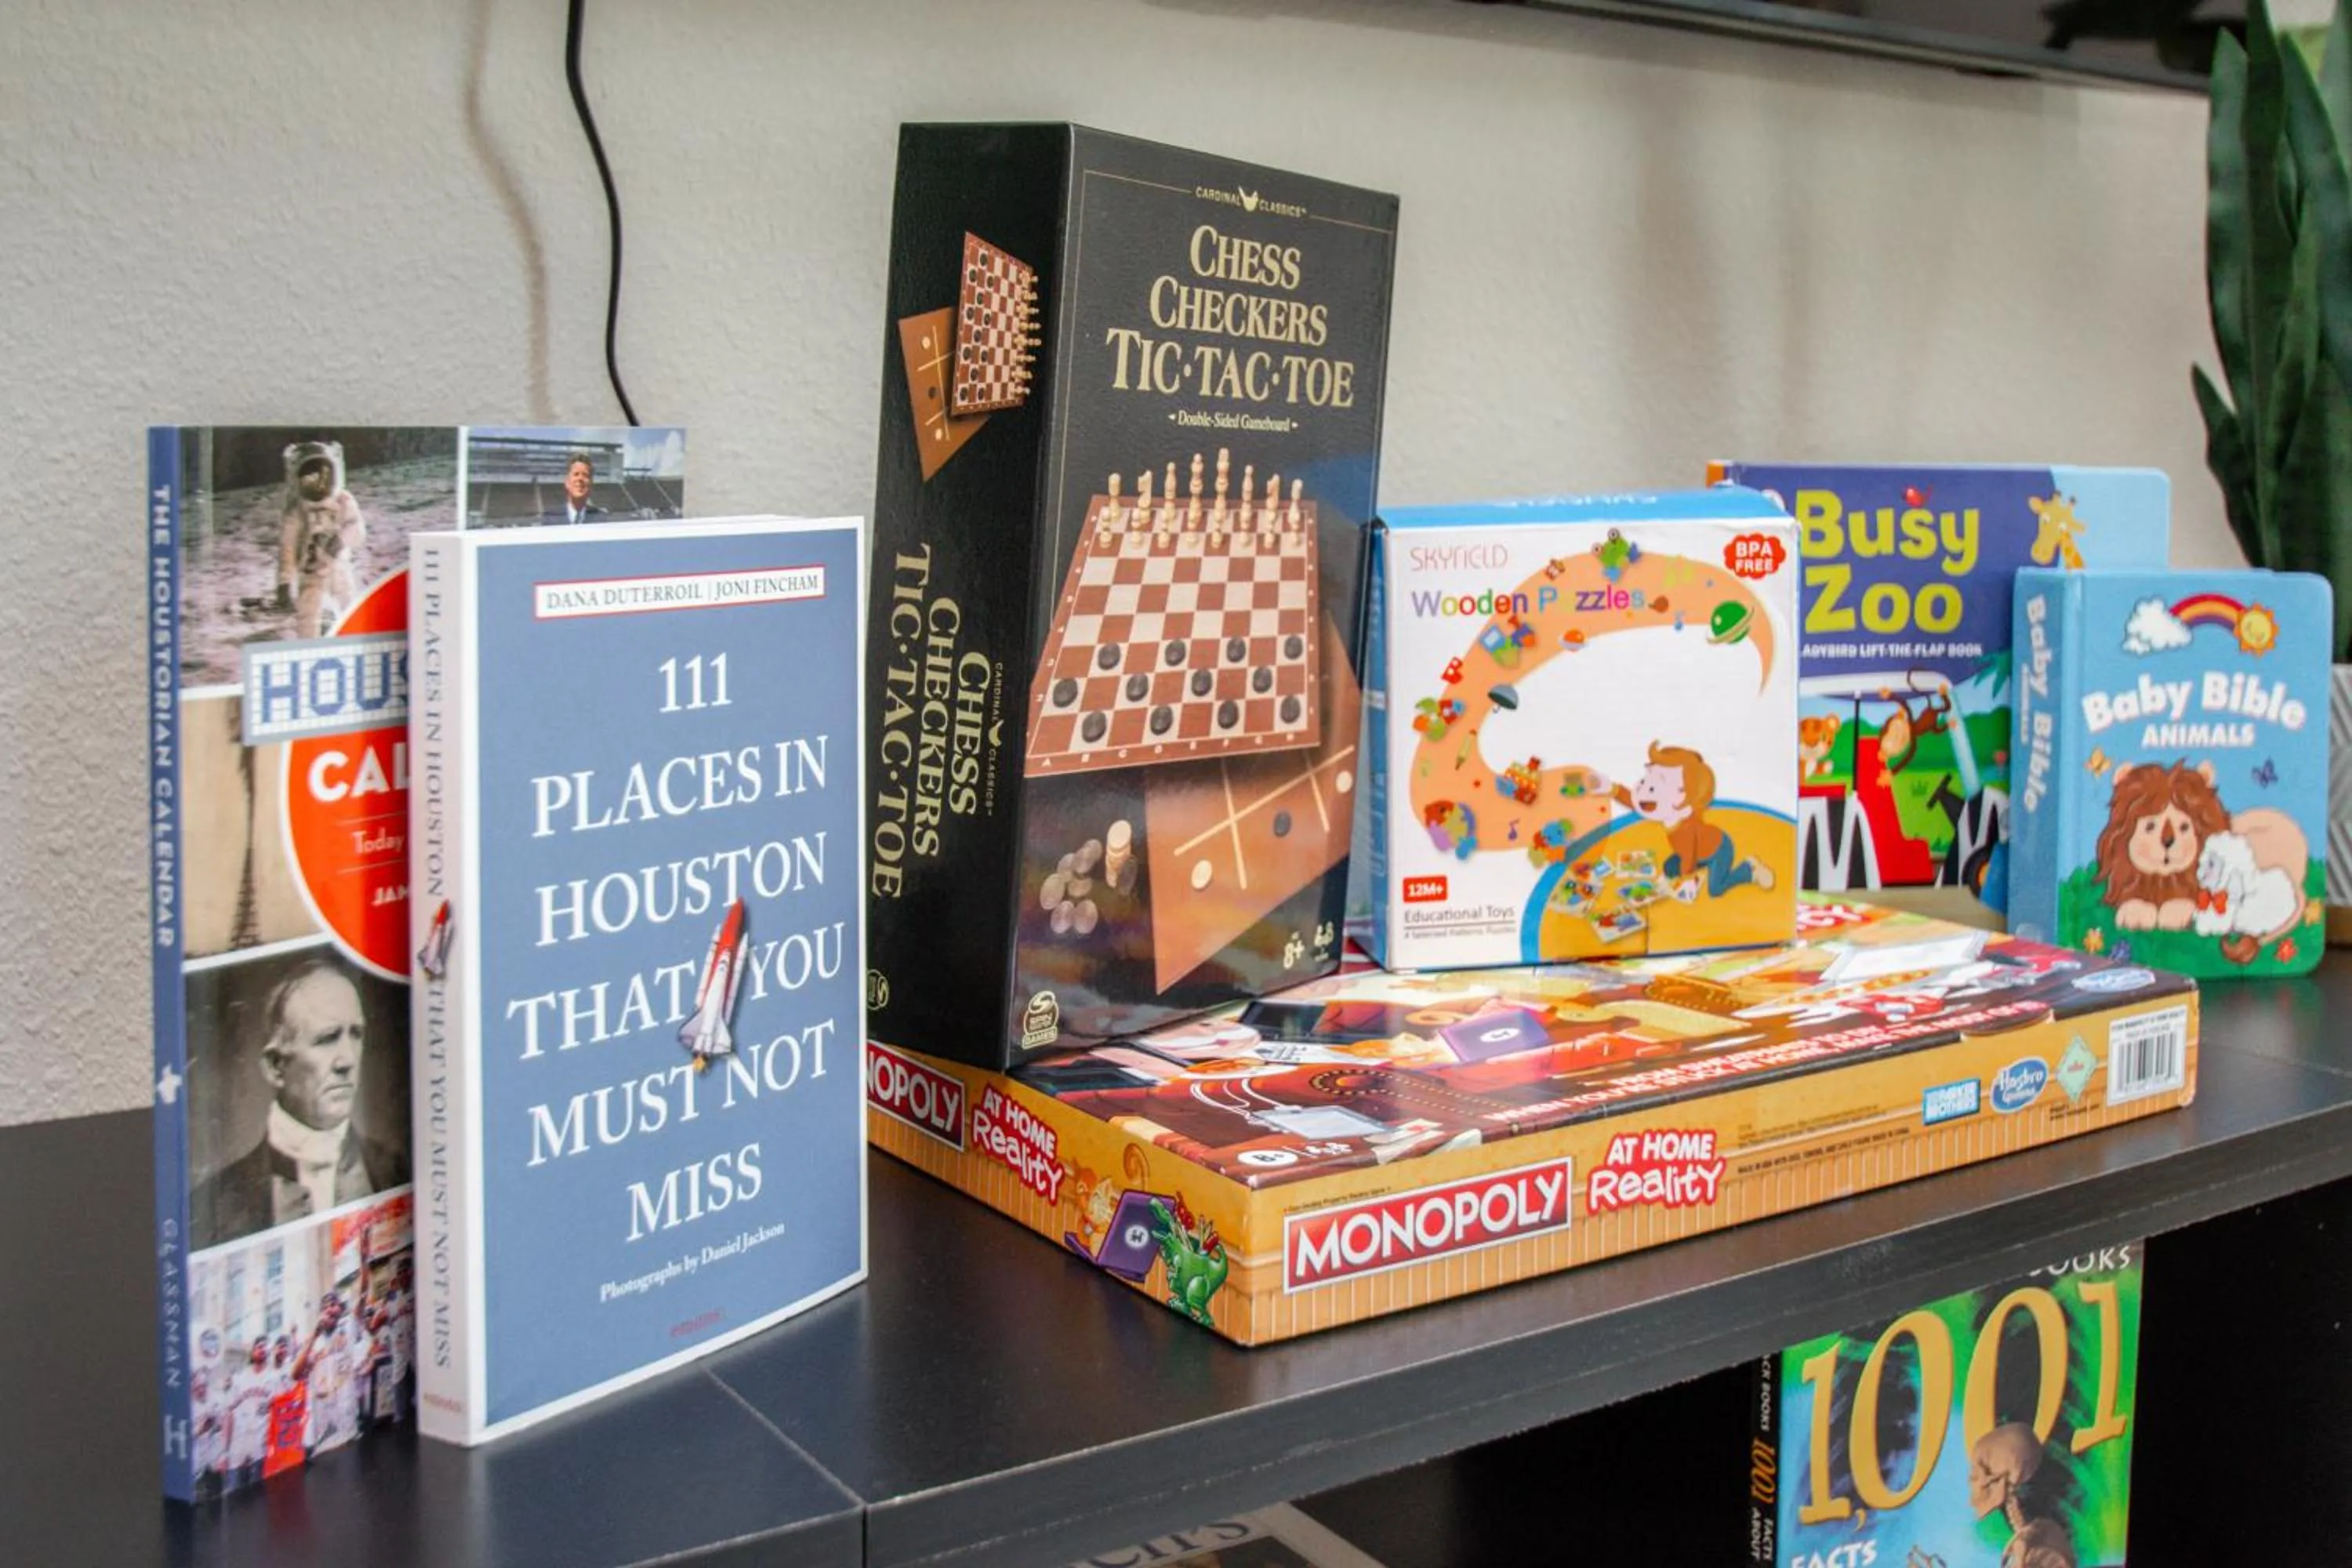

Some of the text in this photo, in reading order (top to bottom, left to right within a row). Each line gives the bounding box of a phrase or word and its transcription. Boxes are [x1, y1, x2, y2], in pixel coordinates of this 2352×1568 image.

[1195, 186, 1242, 209] CARDINAL
[1189, 225, 1302, 289] CHESS
[1149, 275, 1328, 347] CHECKERS
[1735, 540, 1773, 559] BPA
[1736, 558, 1773, 574] FREE
[1795, 488, 1980, 576] Busy
[547, 588, 600, 611] DANA
[713, 575, 751, 602] JONI
[753, 573, 818, 596] FINCHAM
[1412, 588, 1529, 618] Wooden
[1539, 584, 1645, 614] Pzzles
[1804, 564, 1963, 635] Zoo
[423, 592, 443, 702] PLACES
[658, 652, 733, 713] 111
[1801, 643, 1857, 659] ADYBIRD
[1947, 642, 1983, 658] BOOK
[154, 484, 175, 947] THE HOUSTONIAN CALENDAR
[425, 711, 444, 742] IN
[912, 596, 961, 858] CHECKERS
[949, 651, 991, 815] CHESS
[2024, 593, 2053, 813] Baby Bible
[2082, 674, 2193, 735] Baby
[2201, 671, 2307, 731] Bible
[2140, 722, 2256, 750] ANIMALS
[530, 735, 829, 839] PLACES IN
[350, 826, 405, 853] Today
[425, 750, 445, 898] HOUSTON
[534, 831, 827, 947] HOUSTON
[1404, 905, 1515, 924] Educational Toys
[1283, 939, 1305, 970] 8+
[428, 985, 446, 1069] THAT
[506, 922, 846, 1061] THAT YOU
[430, 1074, 448, 1135] YOU
[526, 1018, 836, 1167] MUST NOT
[984, 1087, 1056, 1159] AT HOME
[431, 1141, 449, 1225] MUST
[1606, 1136, 1635, 1165] AT
[1641, 1132, 1713, 1162] HOME
[625, 1142, 763, 1243] MISS
[1295, 1171, 1563, 1277] MONOPOLY
[433, 1230, 451, 1295] NOT
[599, 1221, 786, 1303] Photographs by Daniel Jackson
[433, 1301, 452, 1370] MISS
